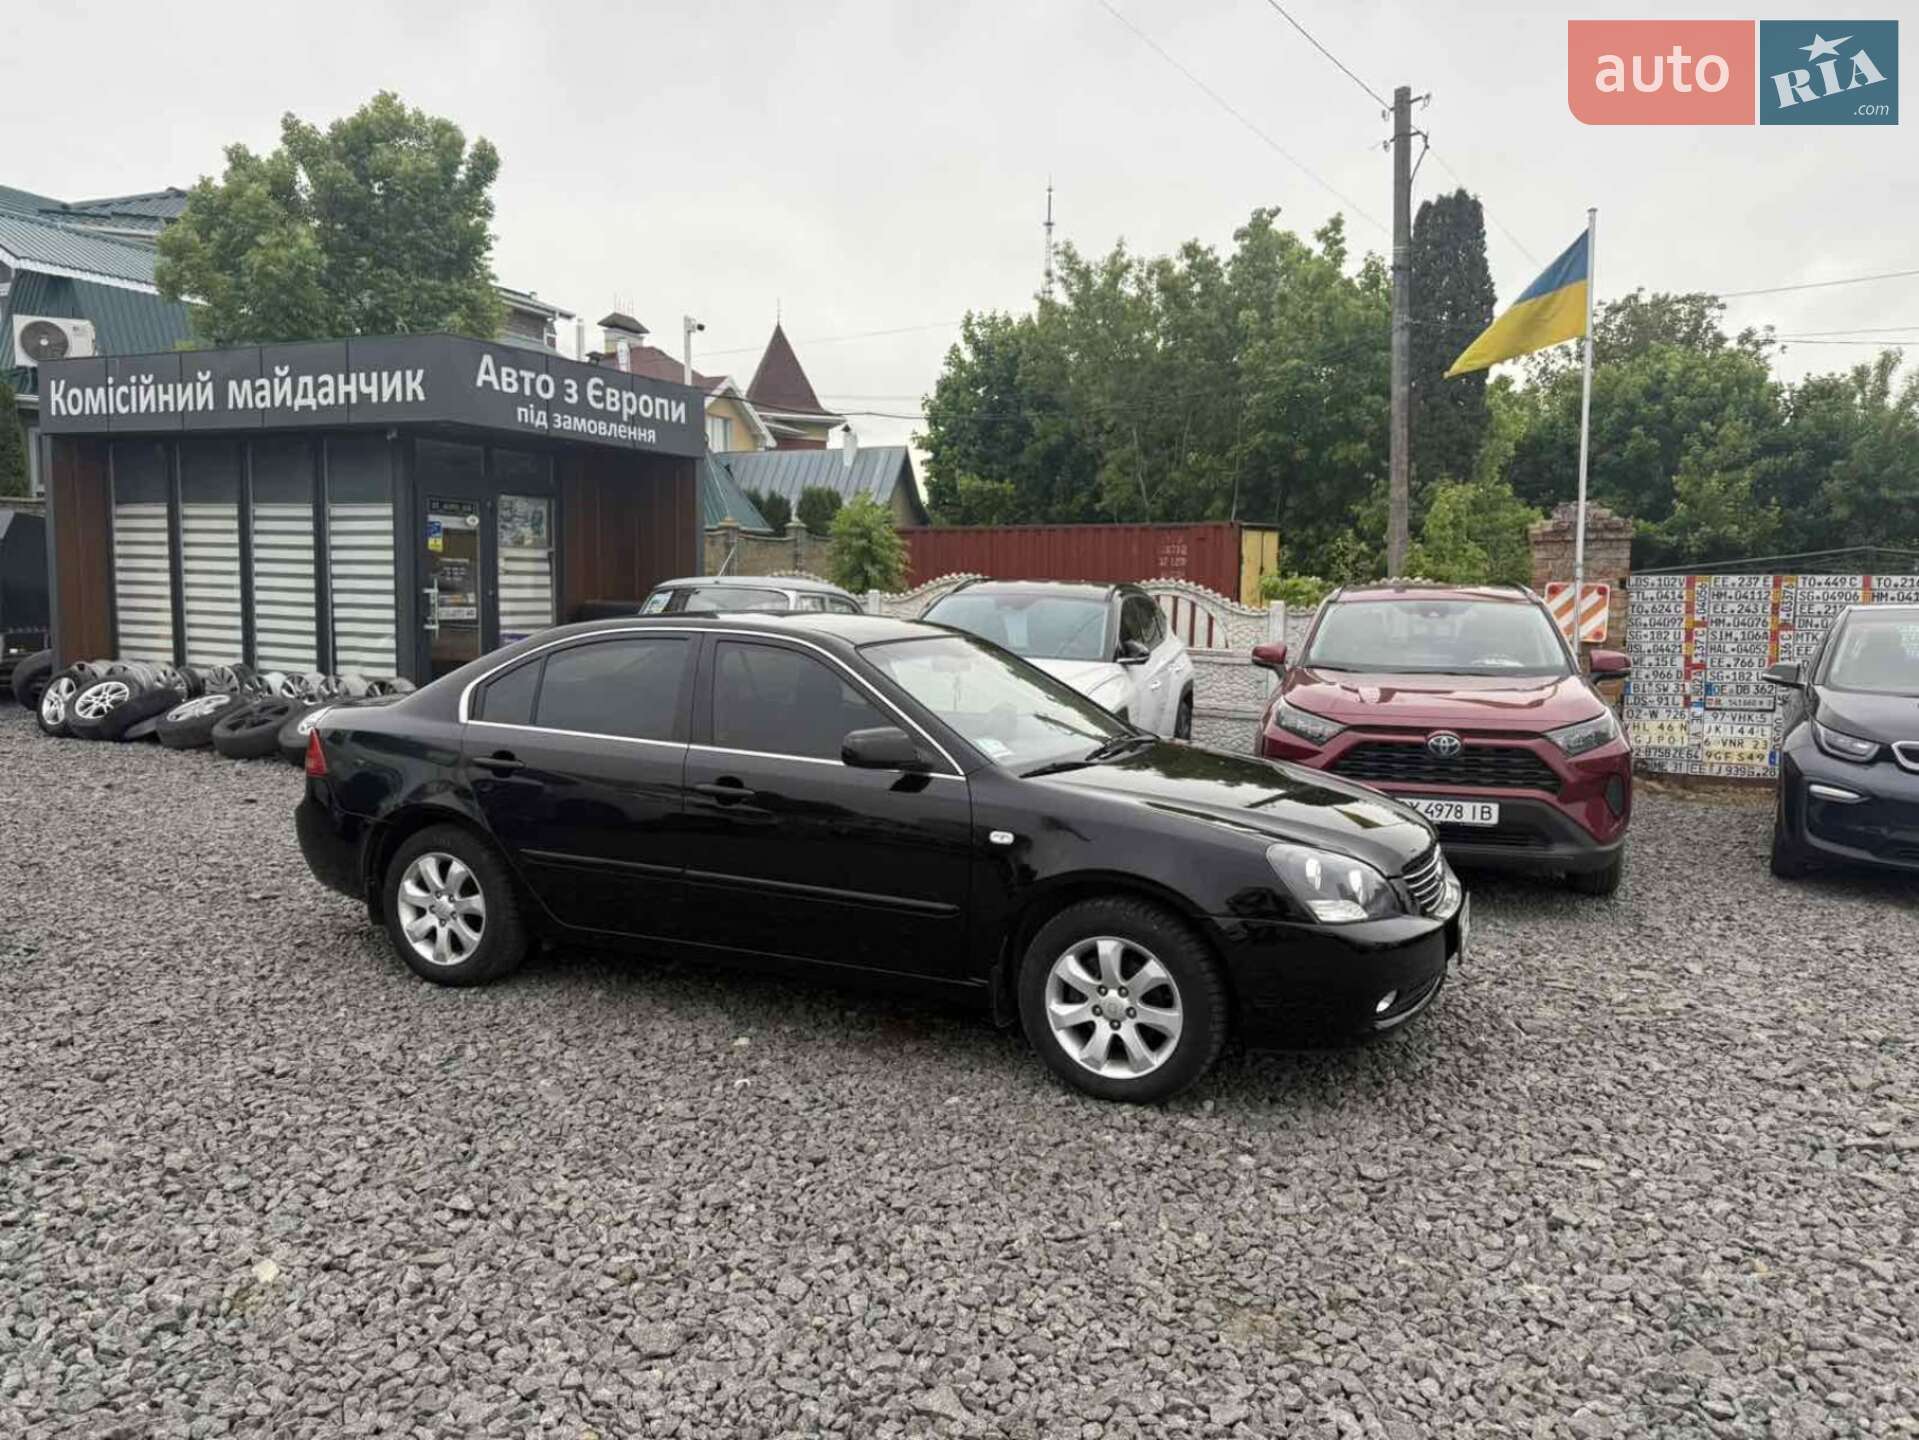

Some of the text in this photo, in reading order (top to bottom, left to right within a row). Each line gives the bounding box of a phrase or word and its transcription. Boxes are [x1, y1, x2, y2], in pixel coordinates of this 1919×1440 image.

[49, 365, 426, 416] Комісійний майданчик
[476, 354, 686, 424] Авто з Європи
[516, 404, 656, 444] під замовлення
[1424, 802, 1464, 819] 4978
[1471, 804, 1492, 821] IB
